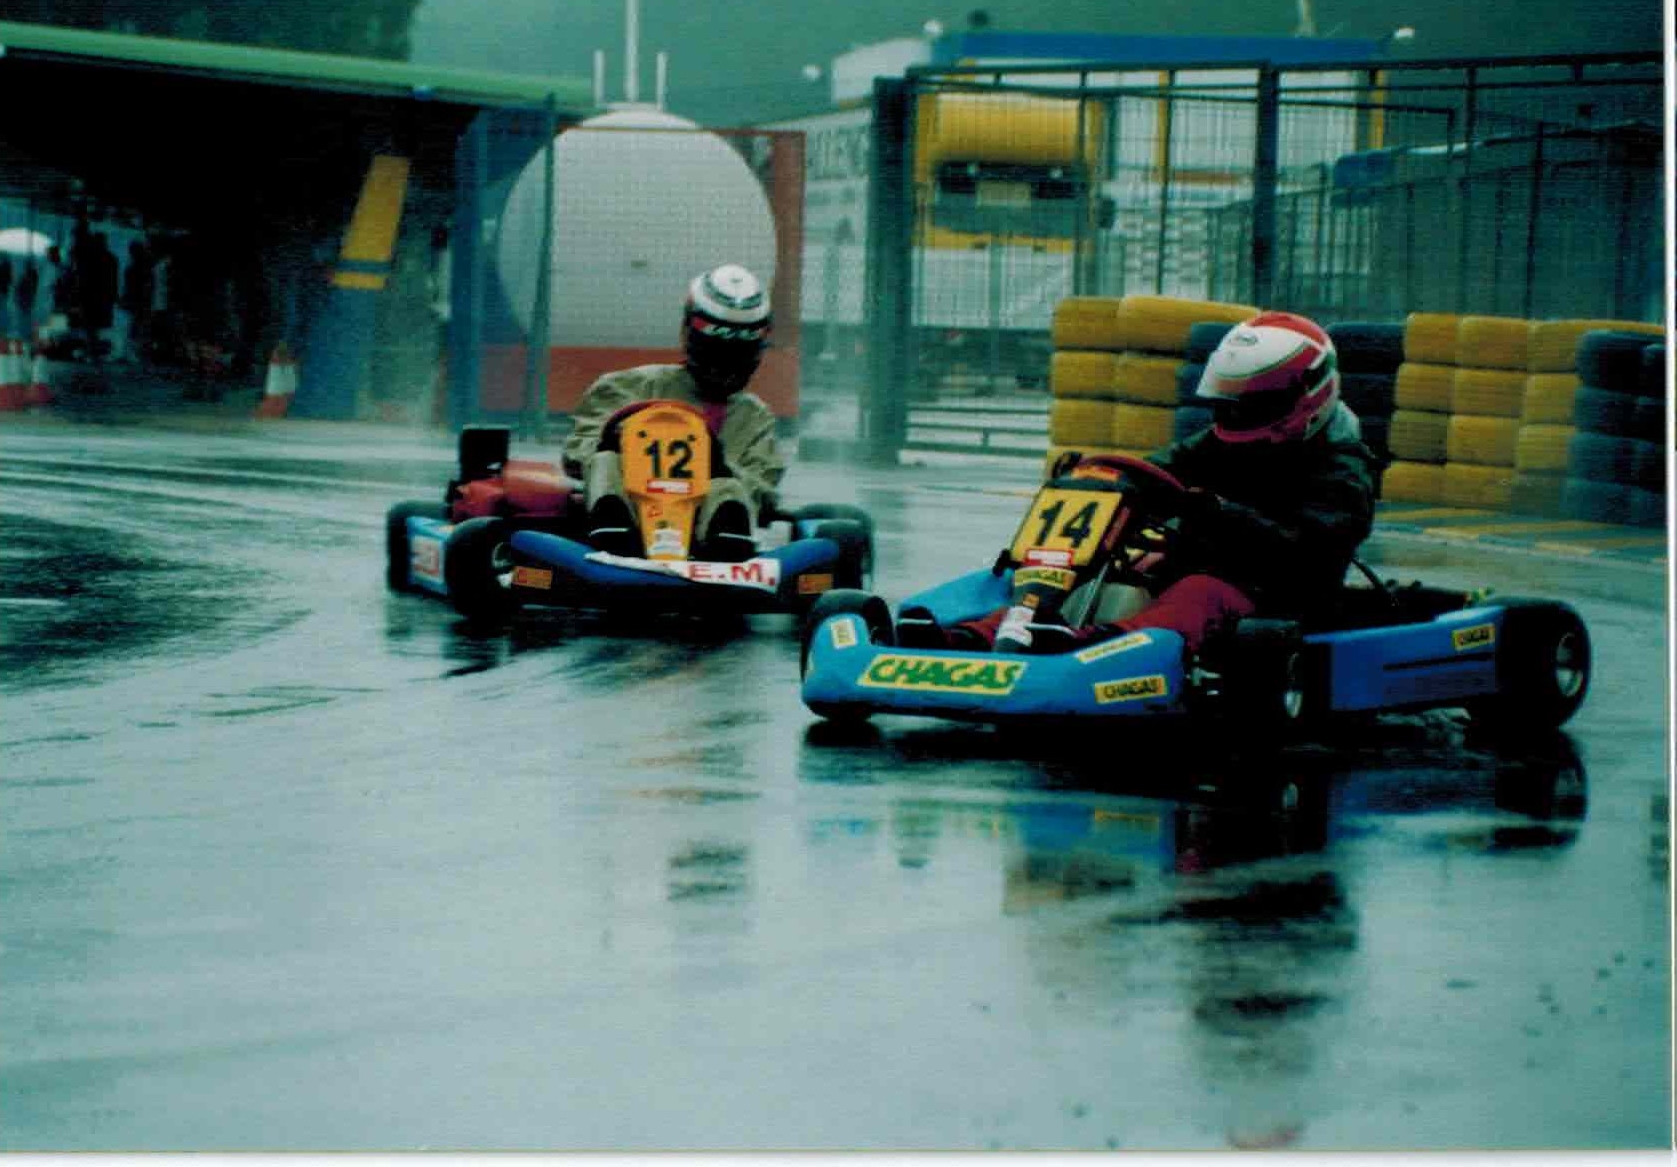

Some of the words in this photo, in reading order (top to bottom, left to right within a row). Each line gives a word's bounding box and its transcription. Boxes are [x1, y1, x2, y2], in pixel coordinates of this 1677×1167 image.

[644, 439, 694, 479] 12
[1034, 500, 1099, 546] 14
[870, 659, 1021, 689] CHAGAS
